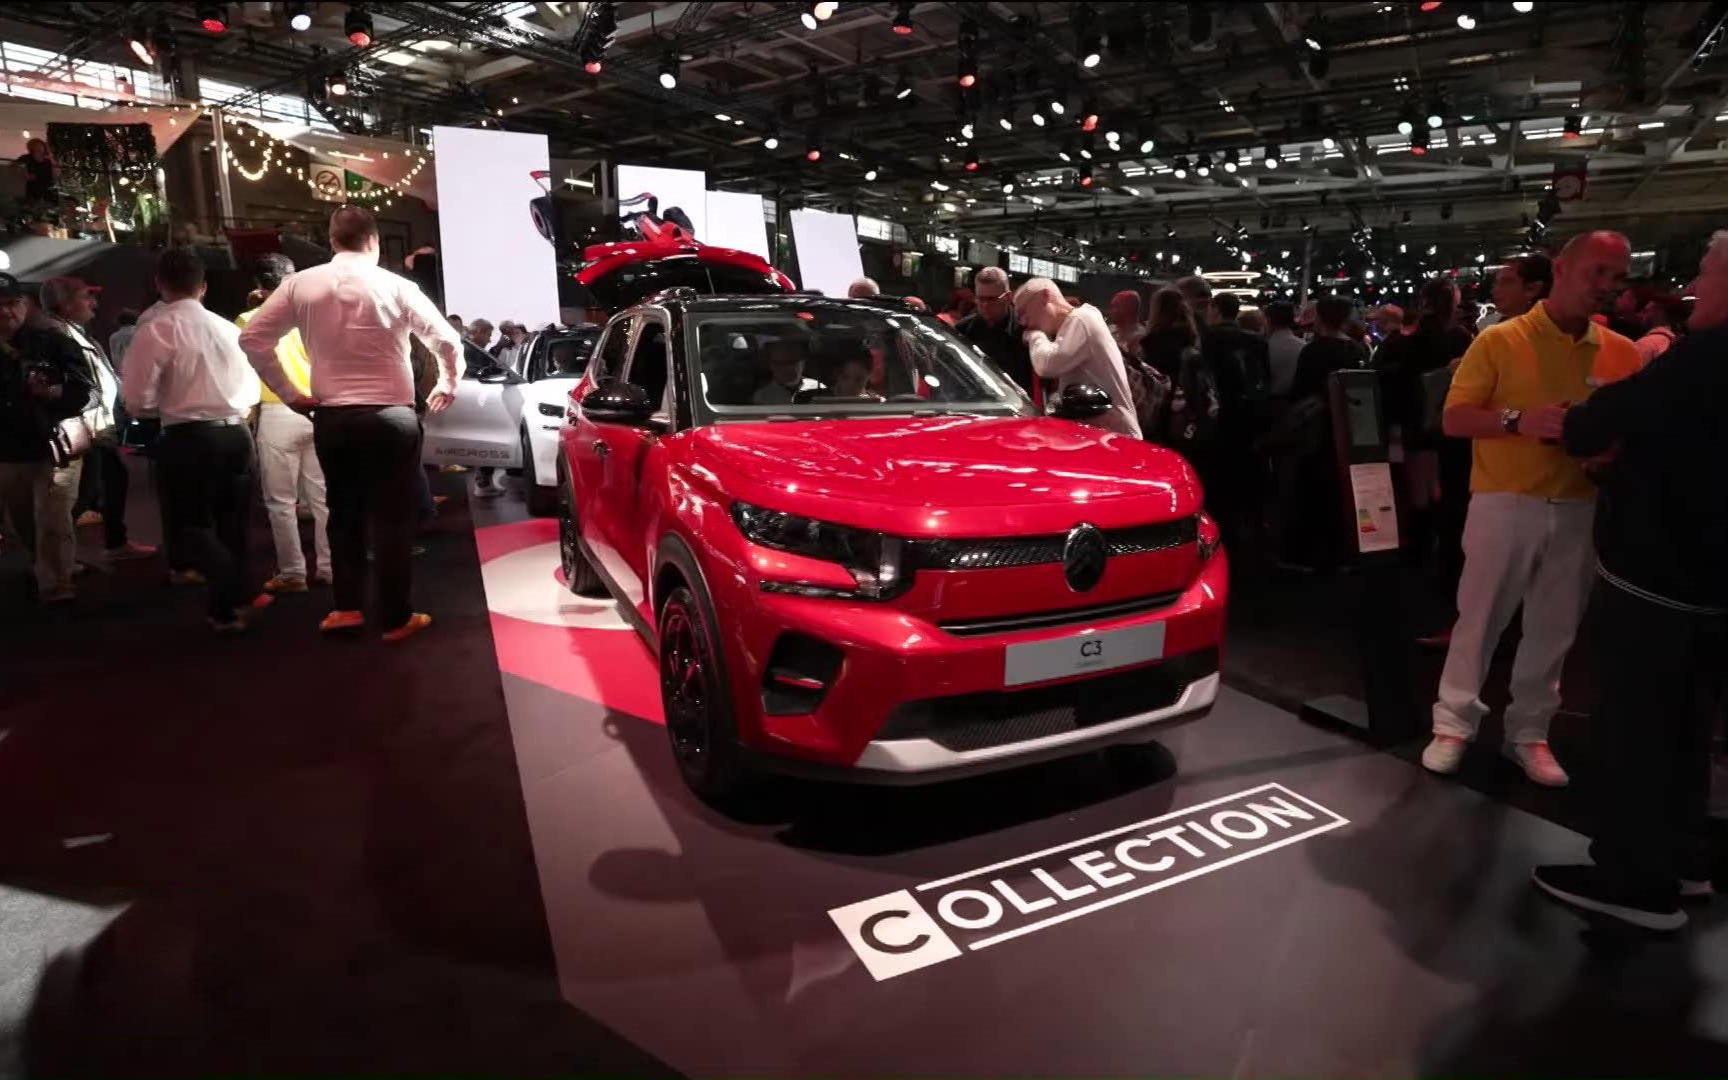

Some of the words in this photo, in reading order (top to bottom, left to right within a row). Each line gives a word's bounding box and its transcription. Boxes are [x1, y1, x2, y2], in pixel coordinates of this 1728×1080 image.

[434, 447, 511, 459] AIRCROSS
[1080, 640, 1102, 657] C3
[859, 796, 1314, 955] COLLECTION
